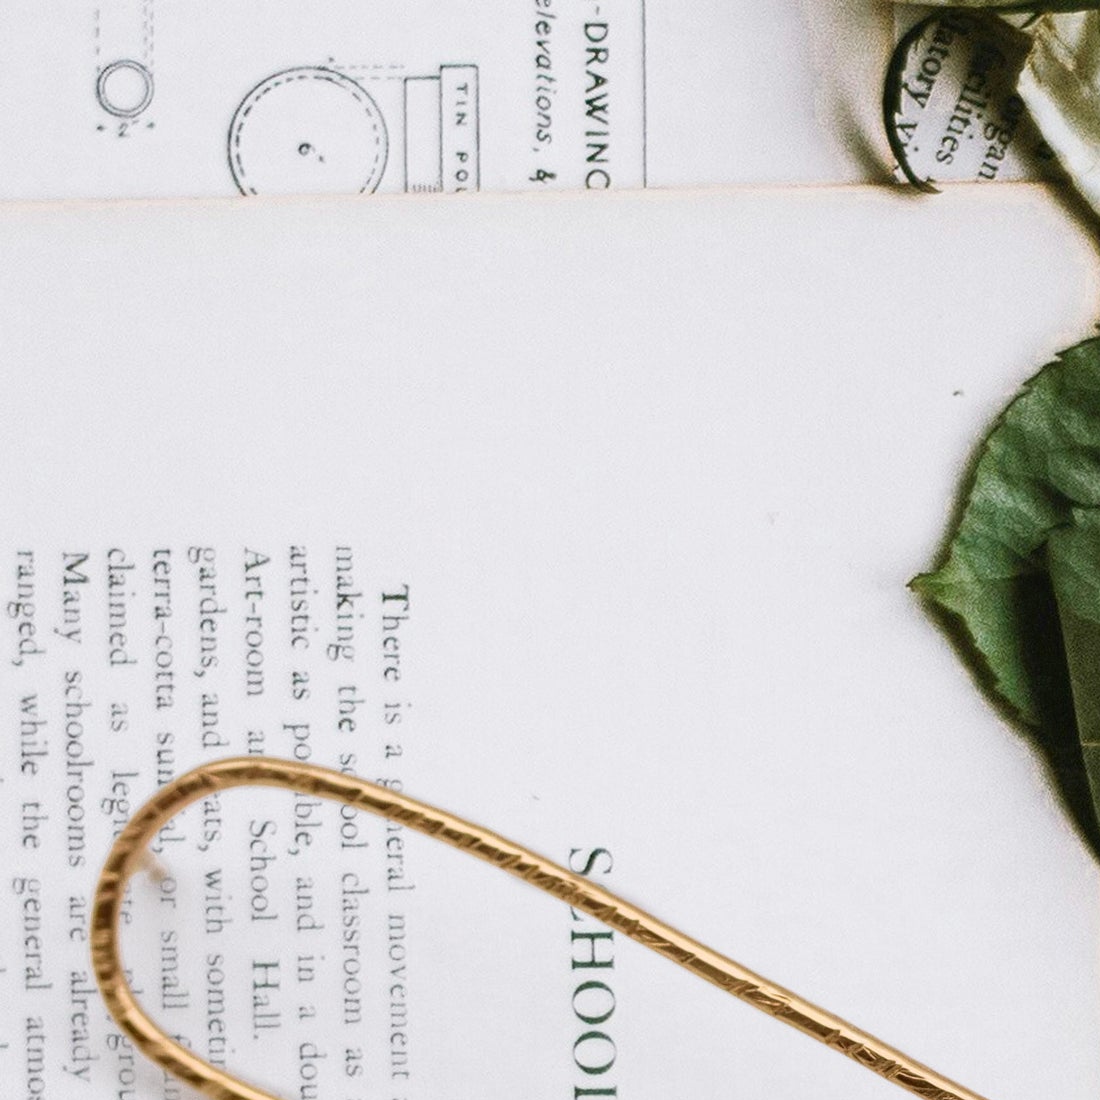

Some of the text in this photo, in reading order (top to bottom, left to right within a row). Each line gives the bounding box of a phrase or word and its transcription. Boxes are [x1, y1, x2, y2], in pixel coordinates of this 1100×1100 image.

[453, 82, 469, 127] TIN
[6, 550, 46, 667] ranged,
[53, 552, 90, 644] Many
[106, 547, 137, 667] claimed
[151, 548, 175, 711] terra-cotta
[187, 546, 227, 678] gardens,
[243, 547, 271, 697] Art-room
[289, 545, 318, 649] artistic
[326, 546, 364, 662] making
[381, 585, 410, 682] There
[110, 703, 128, 732] as
[201, 693, 229, 749] and
[291, 671, 310, 700] as
[337, 685, 365, 733] the
[384, 703, 412, 725] is
[19, 694, 48, 776] while
[64, 671, 94, 868] schoolrooms
[21, 802, 48, 849] the
[204, 868, 232, 934] with
[248, 820, 278, 922] School
[295, 877, 324, 932] and
[12, 877, 53, 991] general
[68, 896, 85, 941] are
[341, 872, 370, 1025] classroom
[160, 931, 189, 1010] small
[251, 960, 281, 1040] Hall.
[297, 956, 325, 983] in
[388, 914, 410, 1079] movement
[62, 971, 98, 1082] already
[344, 1048, 362, 1077] as
